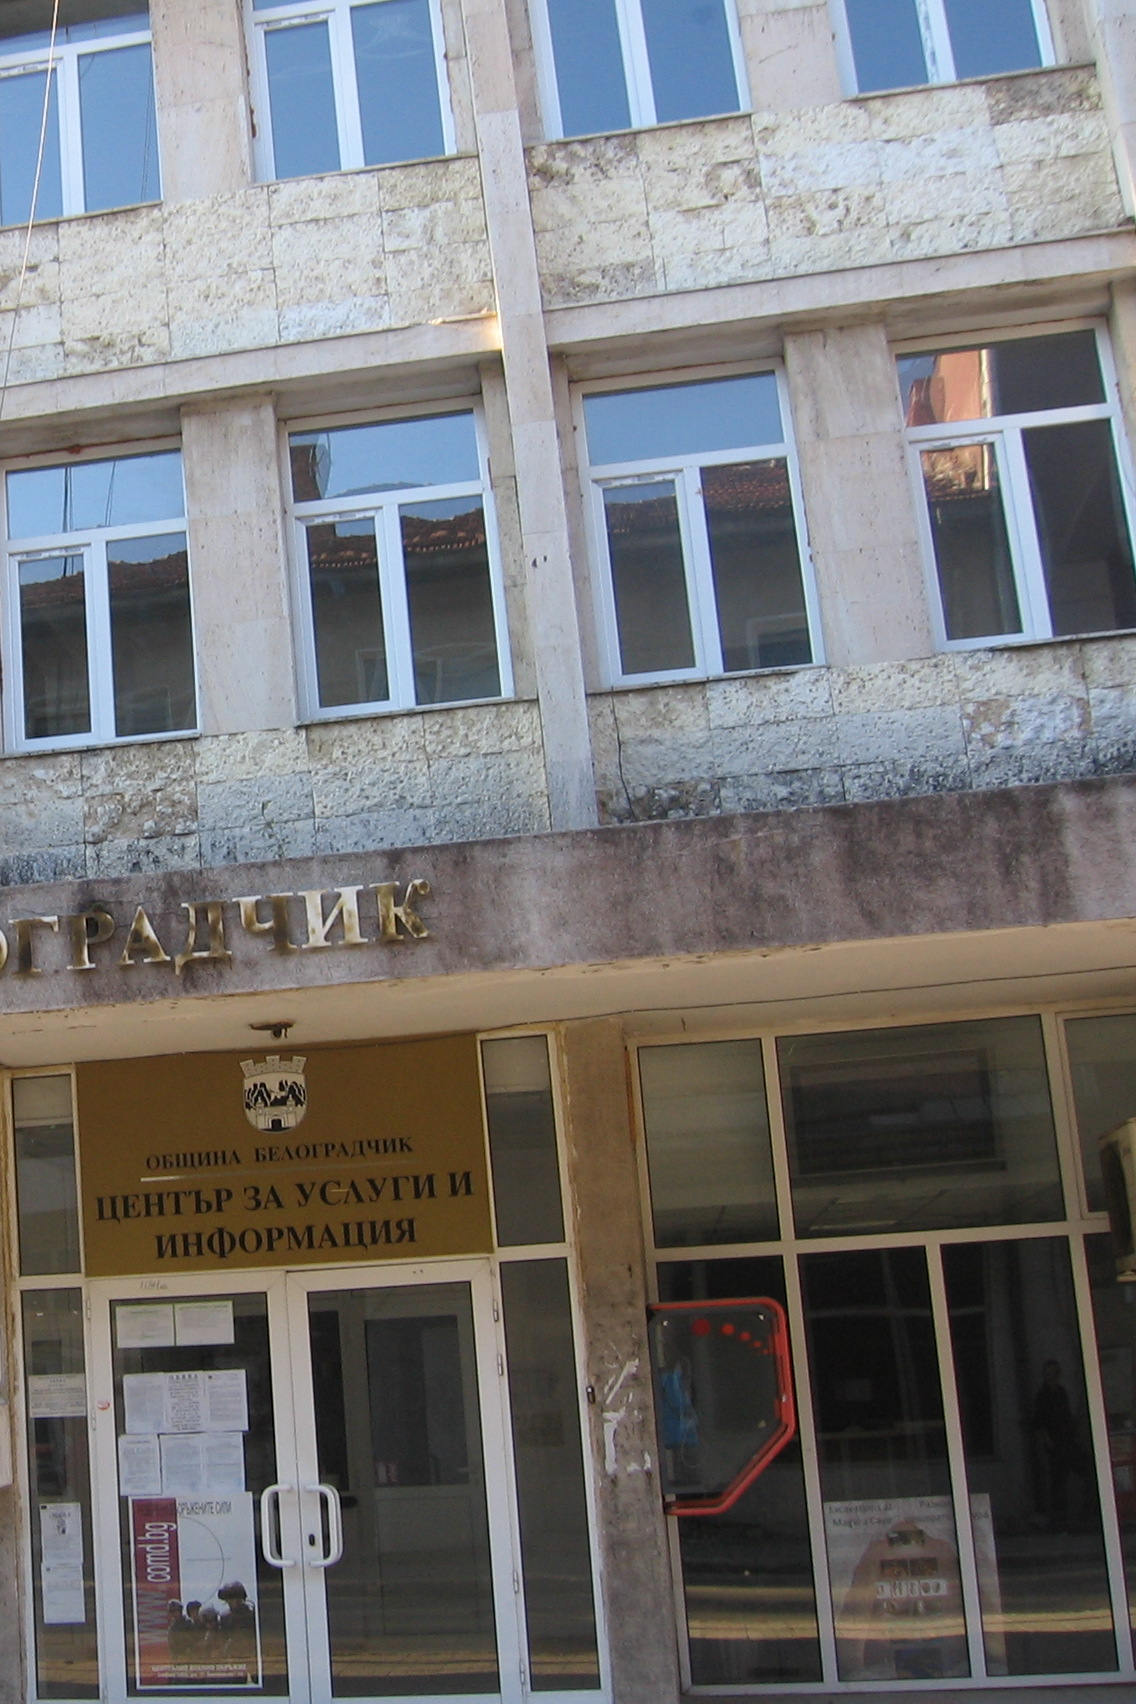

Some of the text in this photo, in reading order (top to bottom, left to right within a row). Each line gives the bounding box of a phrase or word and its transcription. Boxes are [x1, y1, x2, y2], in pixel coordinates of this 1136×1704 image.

[146, 1136, 414, 1171] ОБЩИНА БЕЛОГРАДЧИК
[96, 1171, 475, 1223] ЦЕНТЪР ЗА УСЛУГИ И
[154, 1218, 417, 1260] ИНФОРМАЦИЯ
